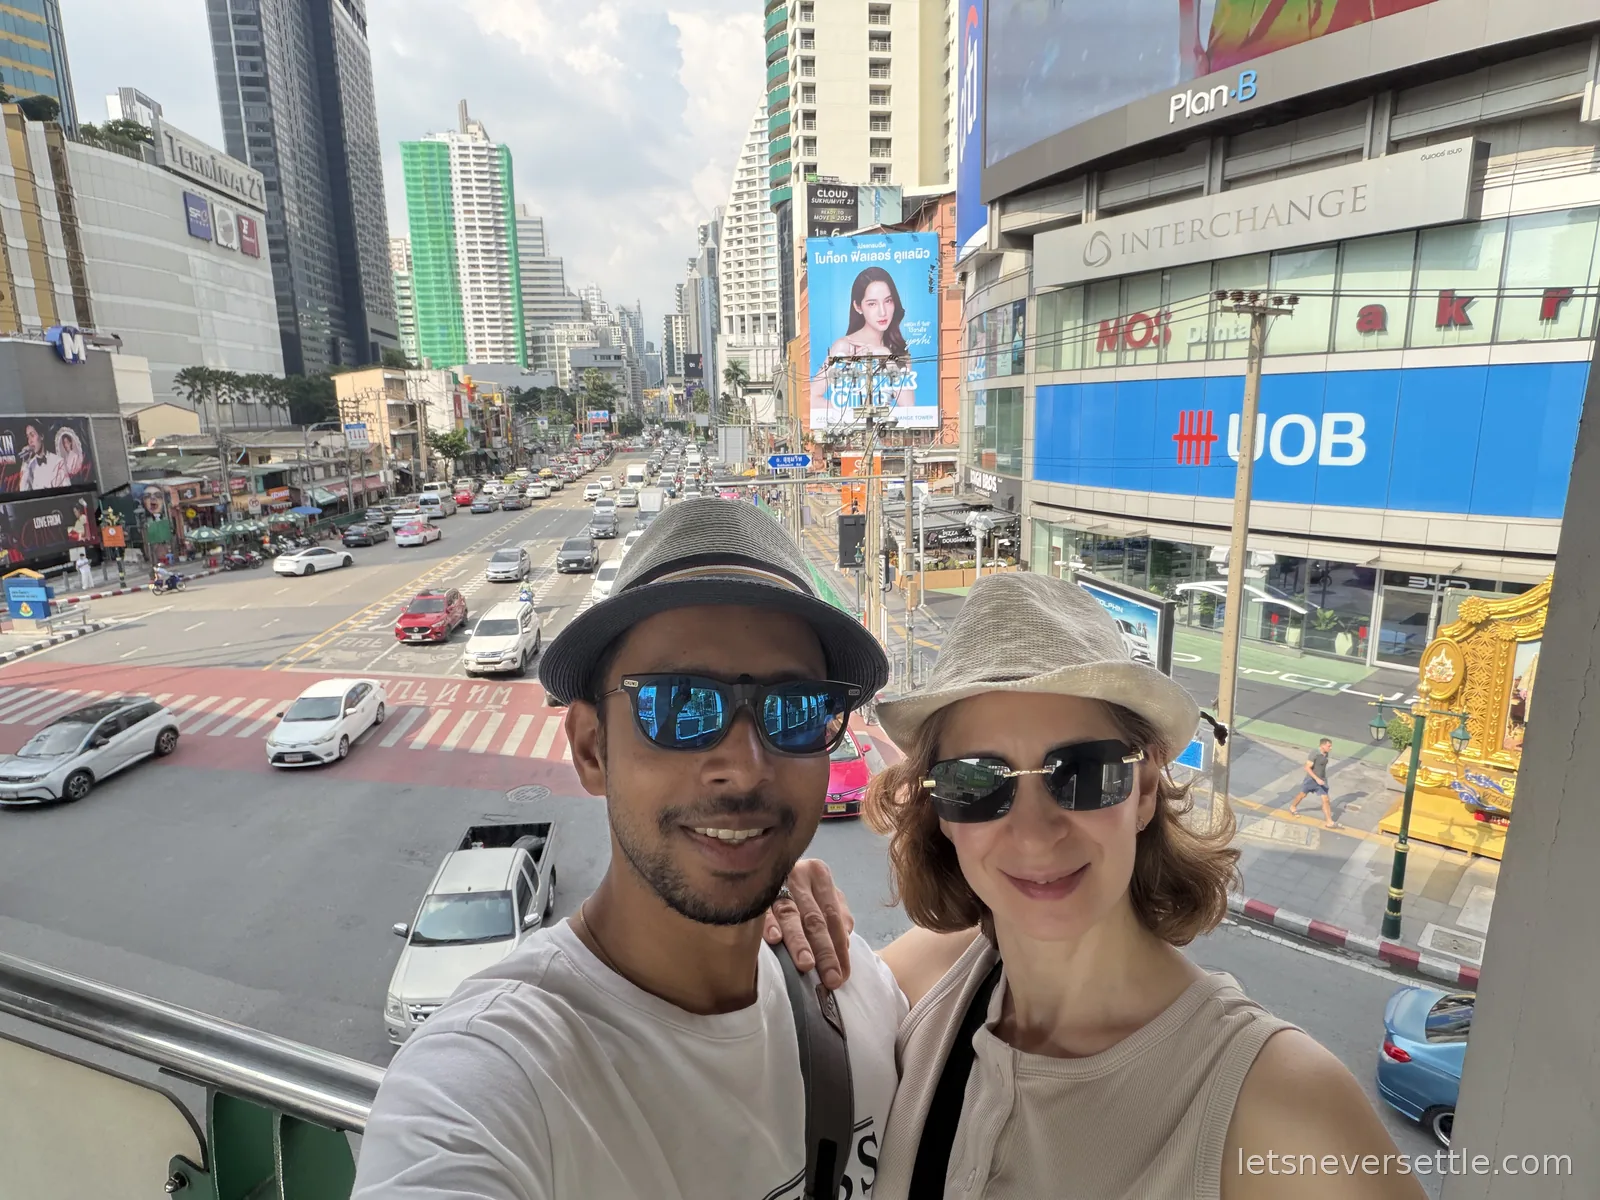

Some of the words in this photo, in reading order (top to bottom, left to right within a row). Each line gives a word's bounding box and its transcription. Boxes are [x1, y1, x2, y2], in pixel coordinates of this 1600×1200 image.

[816, 189, 849, 199] CLOUD
[1121, 184, 1368, 255] INTERCHANGE
[815, 250, 847, 264] โบท็อก
[850, 248, 891, 263] ฟิลเลอร์
[894, 247, 930, 264] ดูแลผิว
[1096, 309, 1173, 352] MOS
[1227, 412, 1366, 467] UOB
